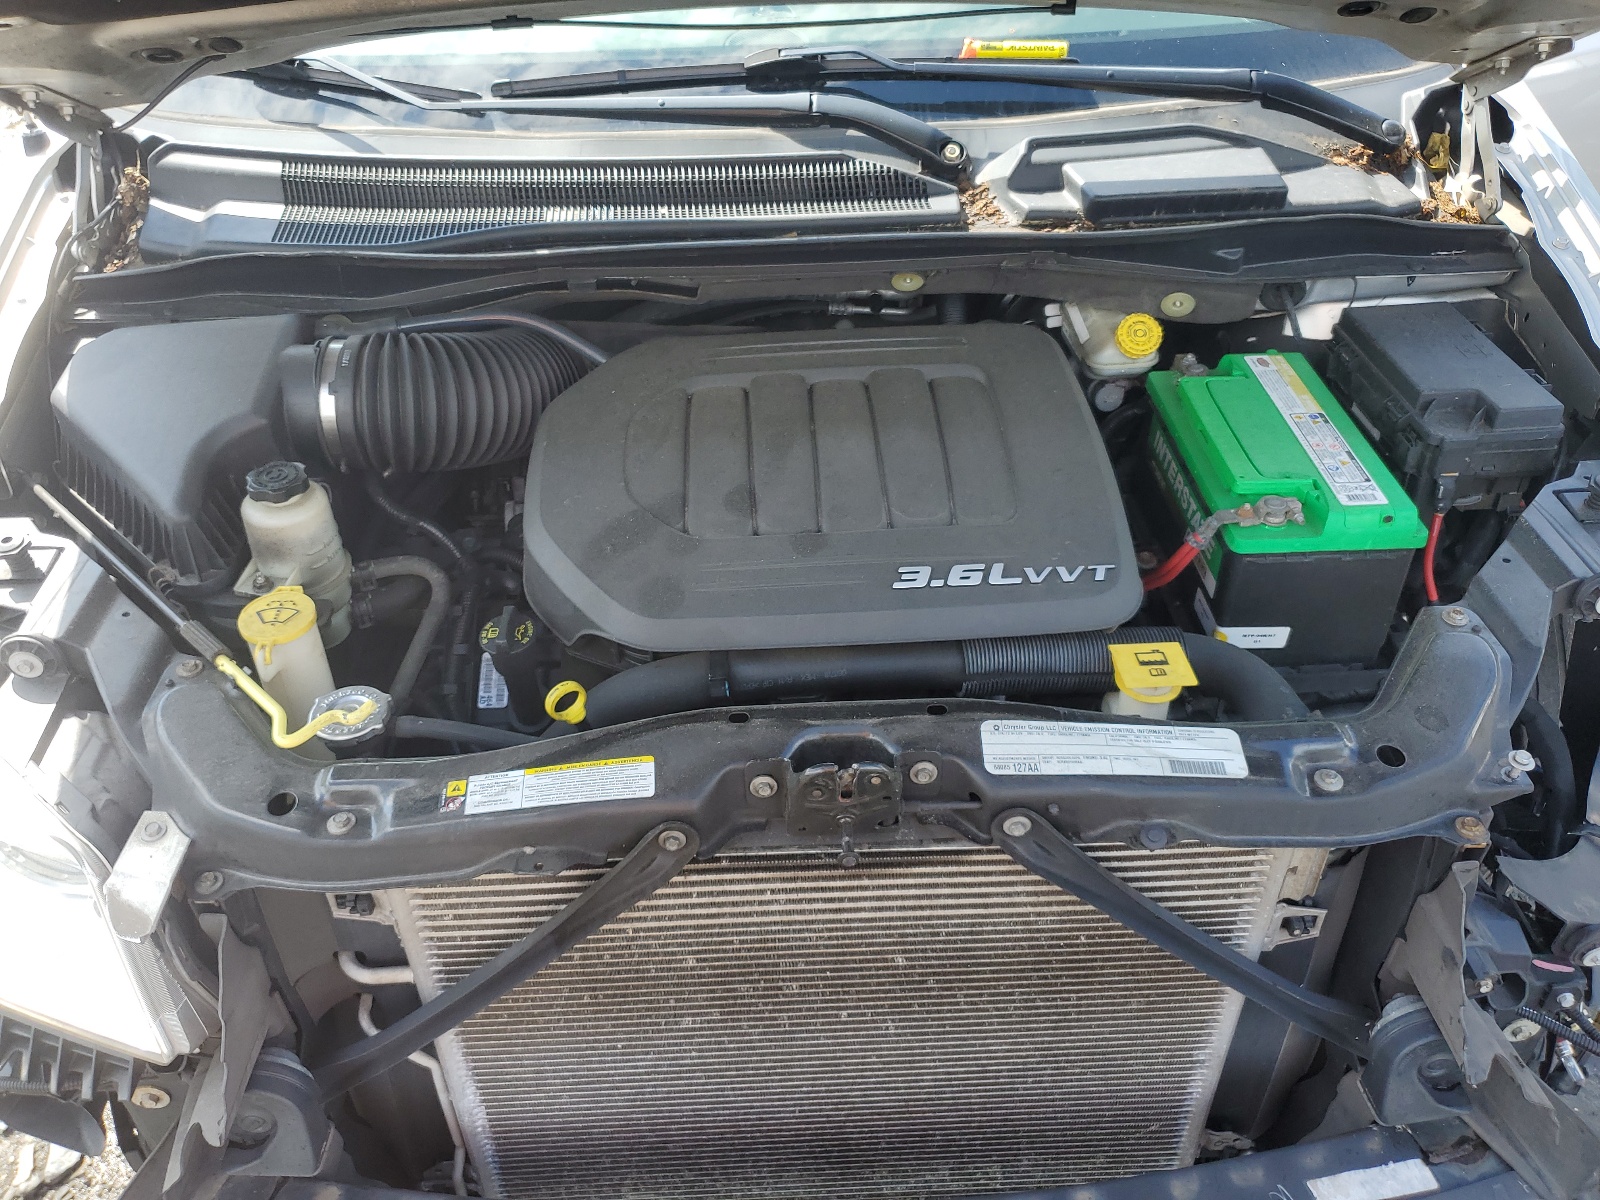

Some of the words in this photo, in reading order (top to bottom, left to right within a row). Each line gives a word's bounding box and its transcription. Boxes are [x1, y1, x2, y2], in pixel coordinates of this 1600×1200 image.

[892, 562, 1023, 589] 3.6L
[1023, 564, 1116, 584] VVT
[1003, 724, 1026, 732] Chrysler
[1028, 724, 1045, 732] Group
[1013, 762, 1039, 772] 127AA
